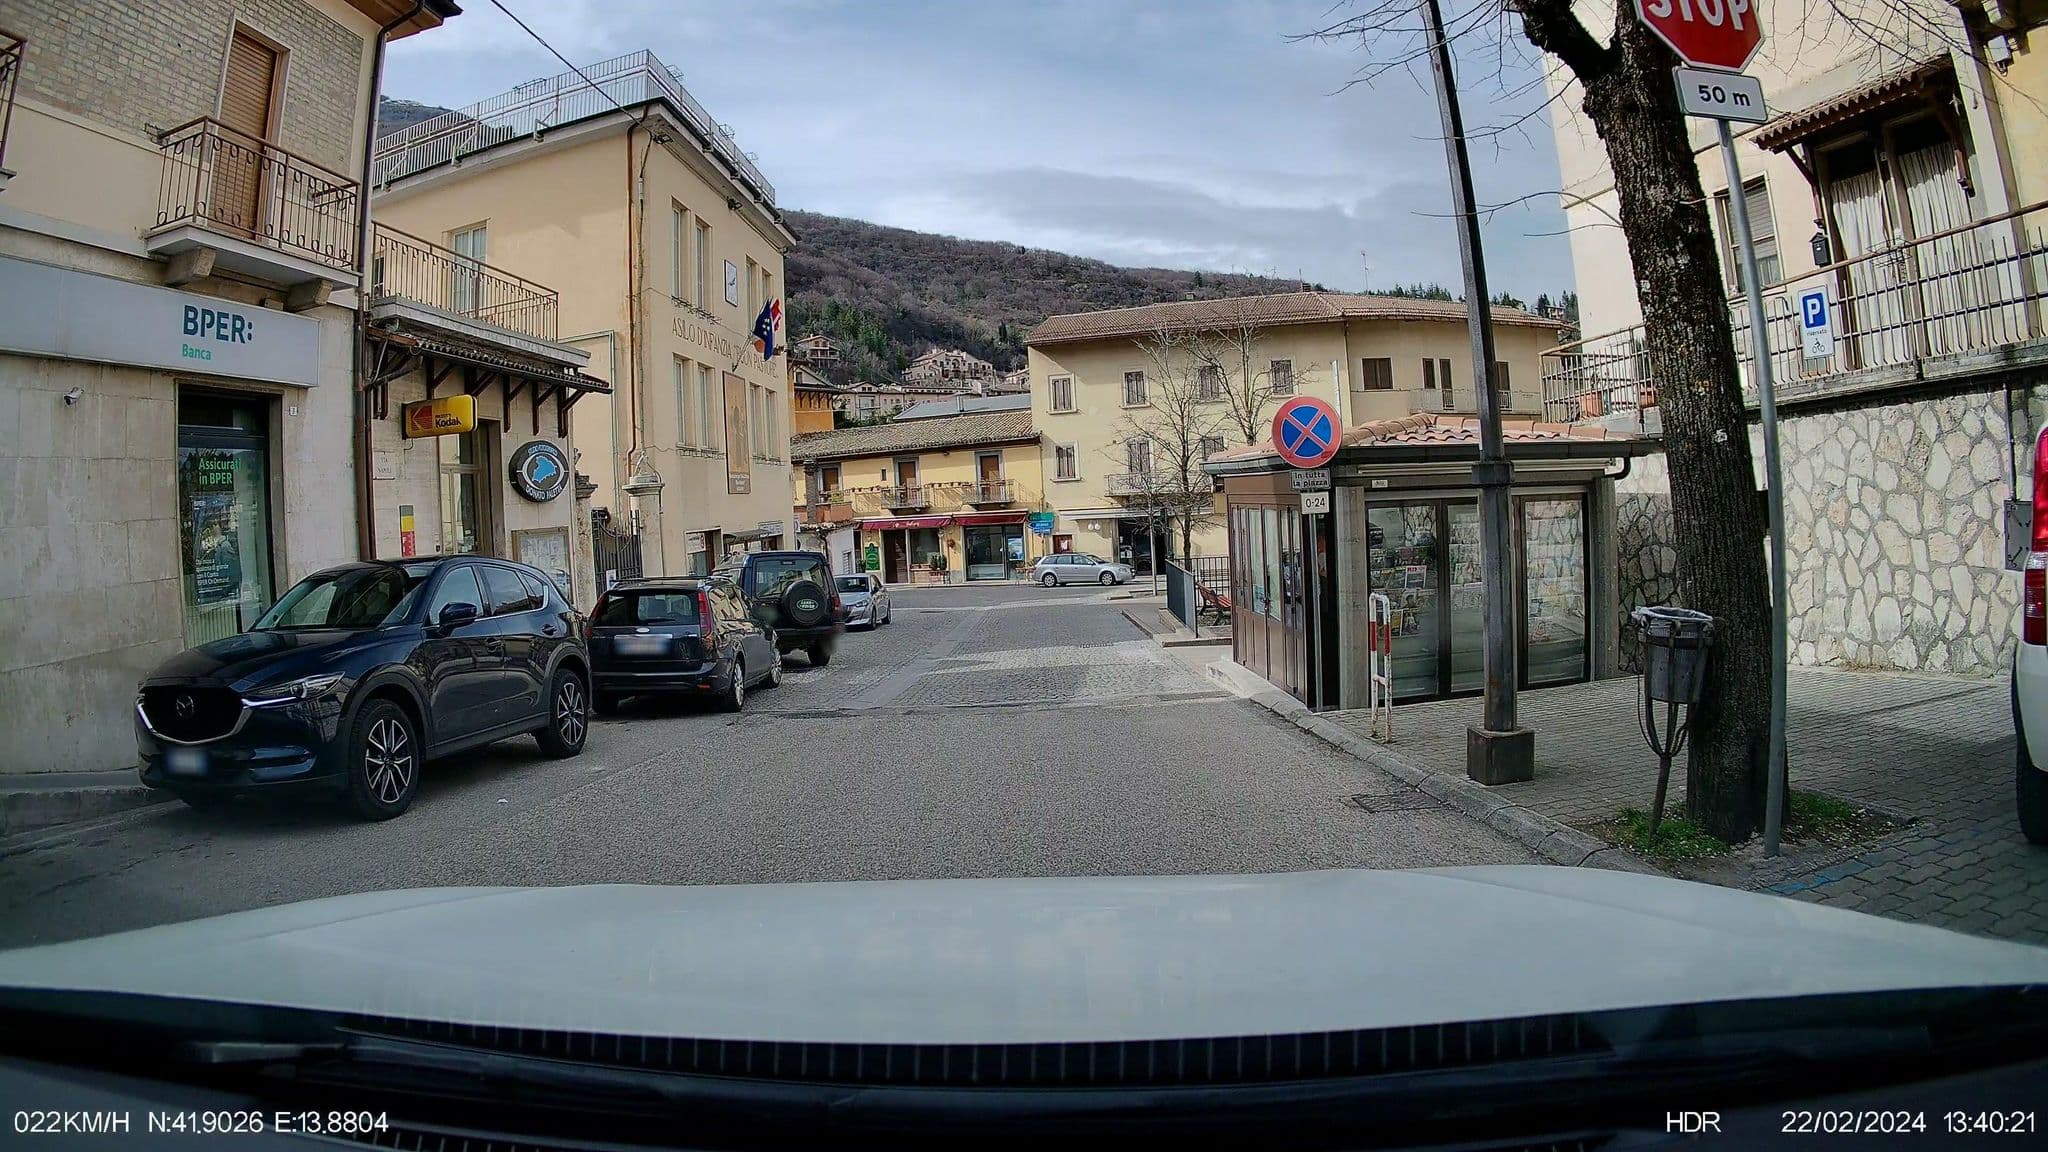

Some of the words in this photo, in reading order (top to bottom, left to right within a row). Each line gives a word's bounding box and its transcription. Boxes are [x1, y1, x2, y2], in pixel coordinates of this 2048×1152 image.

[1698, 84, 1726, 104] 50
[1732, 91, 1751, 107] m
[1806, 298, 1821, 324] P
[183, 304, 253, 344] BPER:
[182, 343, 212, 361] Banca
[435, 416, 462, 429] Kodak
[198, 457, 241, 471] Assicurati
[199, 472, 208, 486] in
[209, 472, 233, 486] BPER
[1305, 471, 1326, 479] tutta
[1303, 479, 1328, 488] piazza
